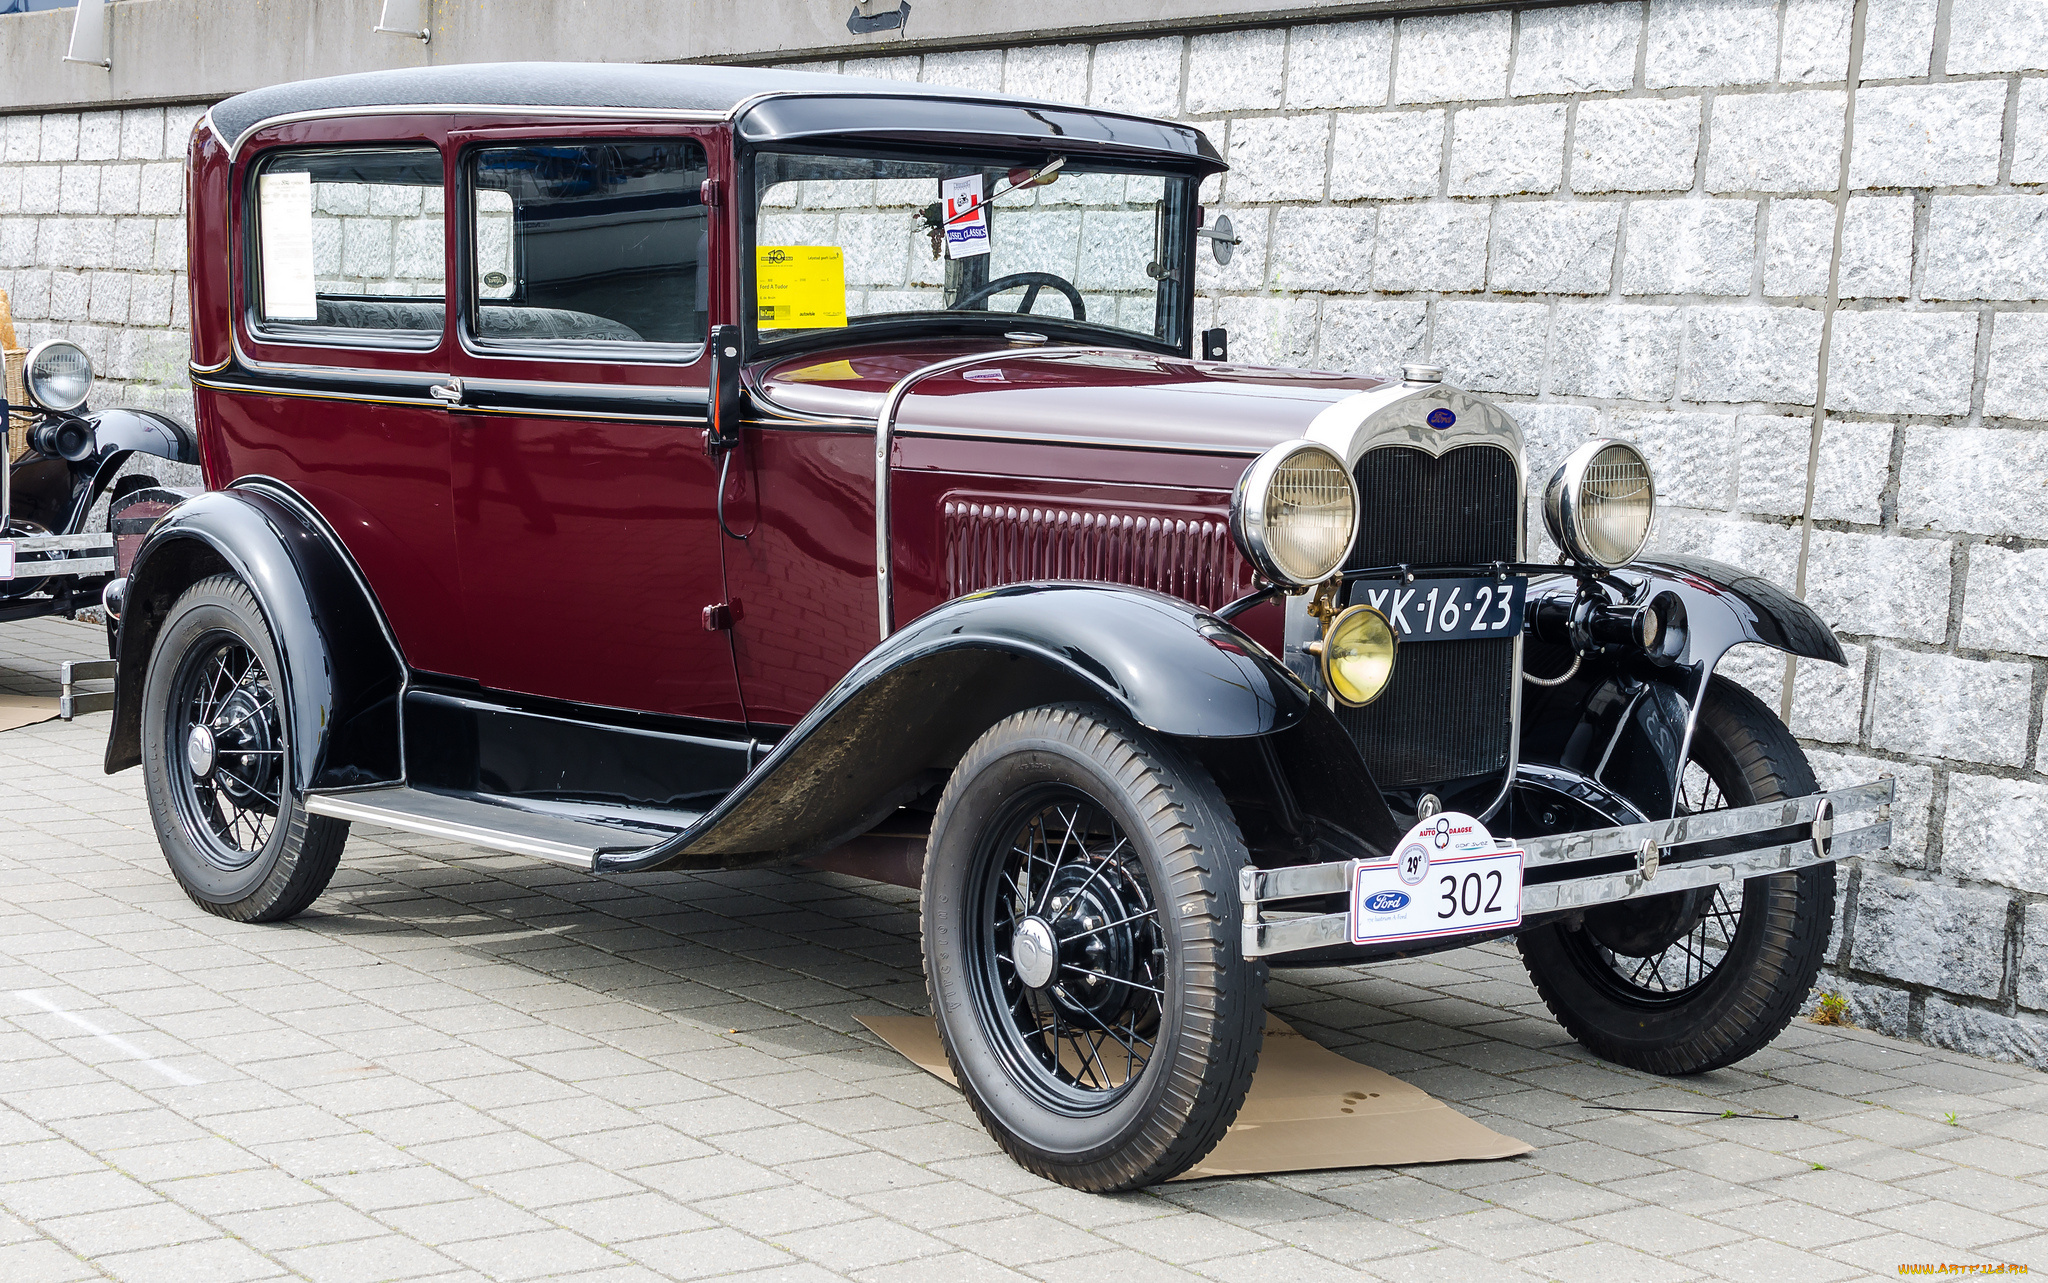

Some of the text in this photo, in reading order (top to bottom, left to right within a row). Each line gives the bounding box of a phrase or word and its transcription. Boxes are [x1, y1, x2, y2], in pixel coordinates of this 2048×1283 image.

[963, 228, 986, 239] CLASSICS
[768, 249, 785, 264] 10
[1431, 411, 1453, 423] Ford
[1419, 818, 1473, 849] AUTO 8 DAAGSE
[1373, 893, 1402, 909] Ford
[1438, 870, 1502, 919] 302
